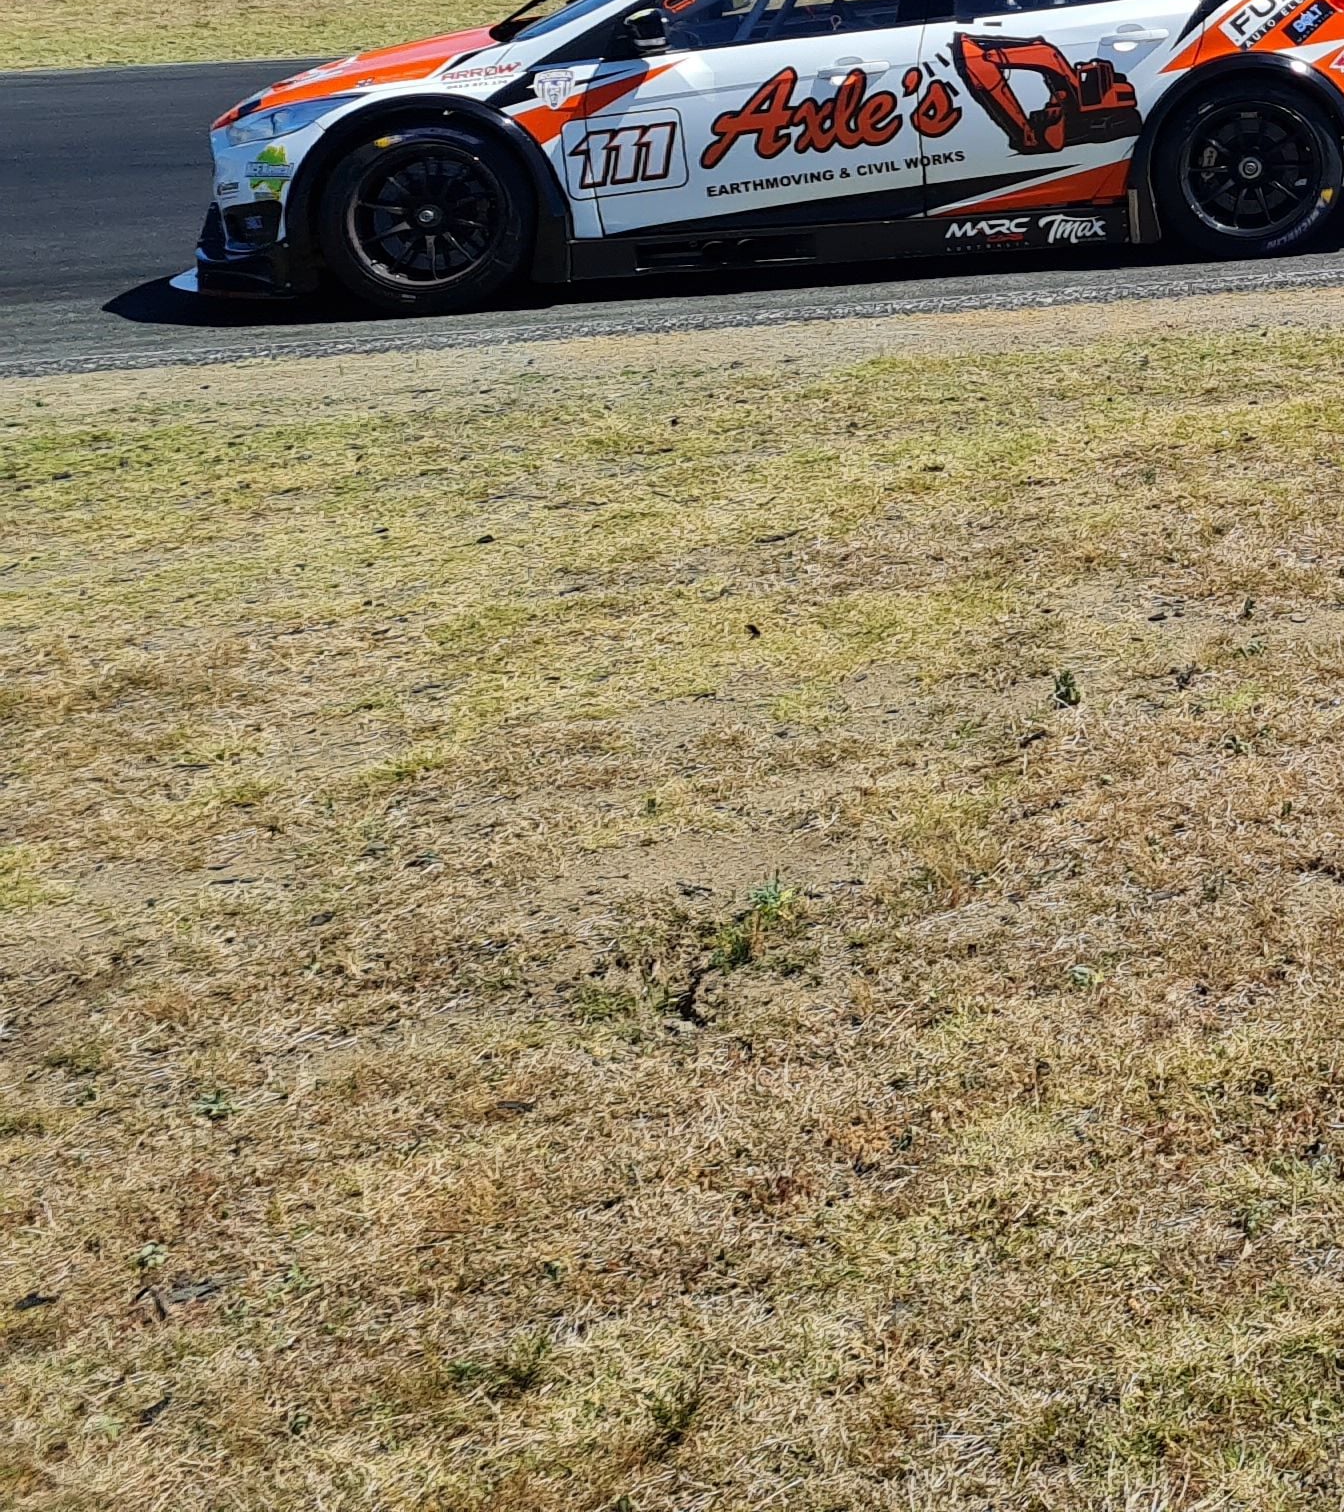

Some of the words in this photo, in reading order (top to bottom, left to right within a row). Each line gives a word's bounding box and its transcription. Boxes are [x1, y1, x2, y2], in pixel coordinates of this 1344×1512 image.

[1244, 18, 1277, 49] AUTO
[441, 61, 522, 81] ARROW
[700, 66, 962, 169] Axle's
[568, 120, 677, 190] 111
[706, 170, 834, 197] EARTHMOVING
[839, 167, 851, 179] &
[856, 160, 901, 176] CIVIL
[904, 150, 966, 169] WORKS
[945, 217, 1032, 238] MARC
[1038, 214, 1107, 243] Tmax
